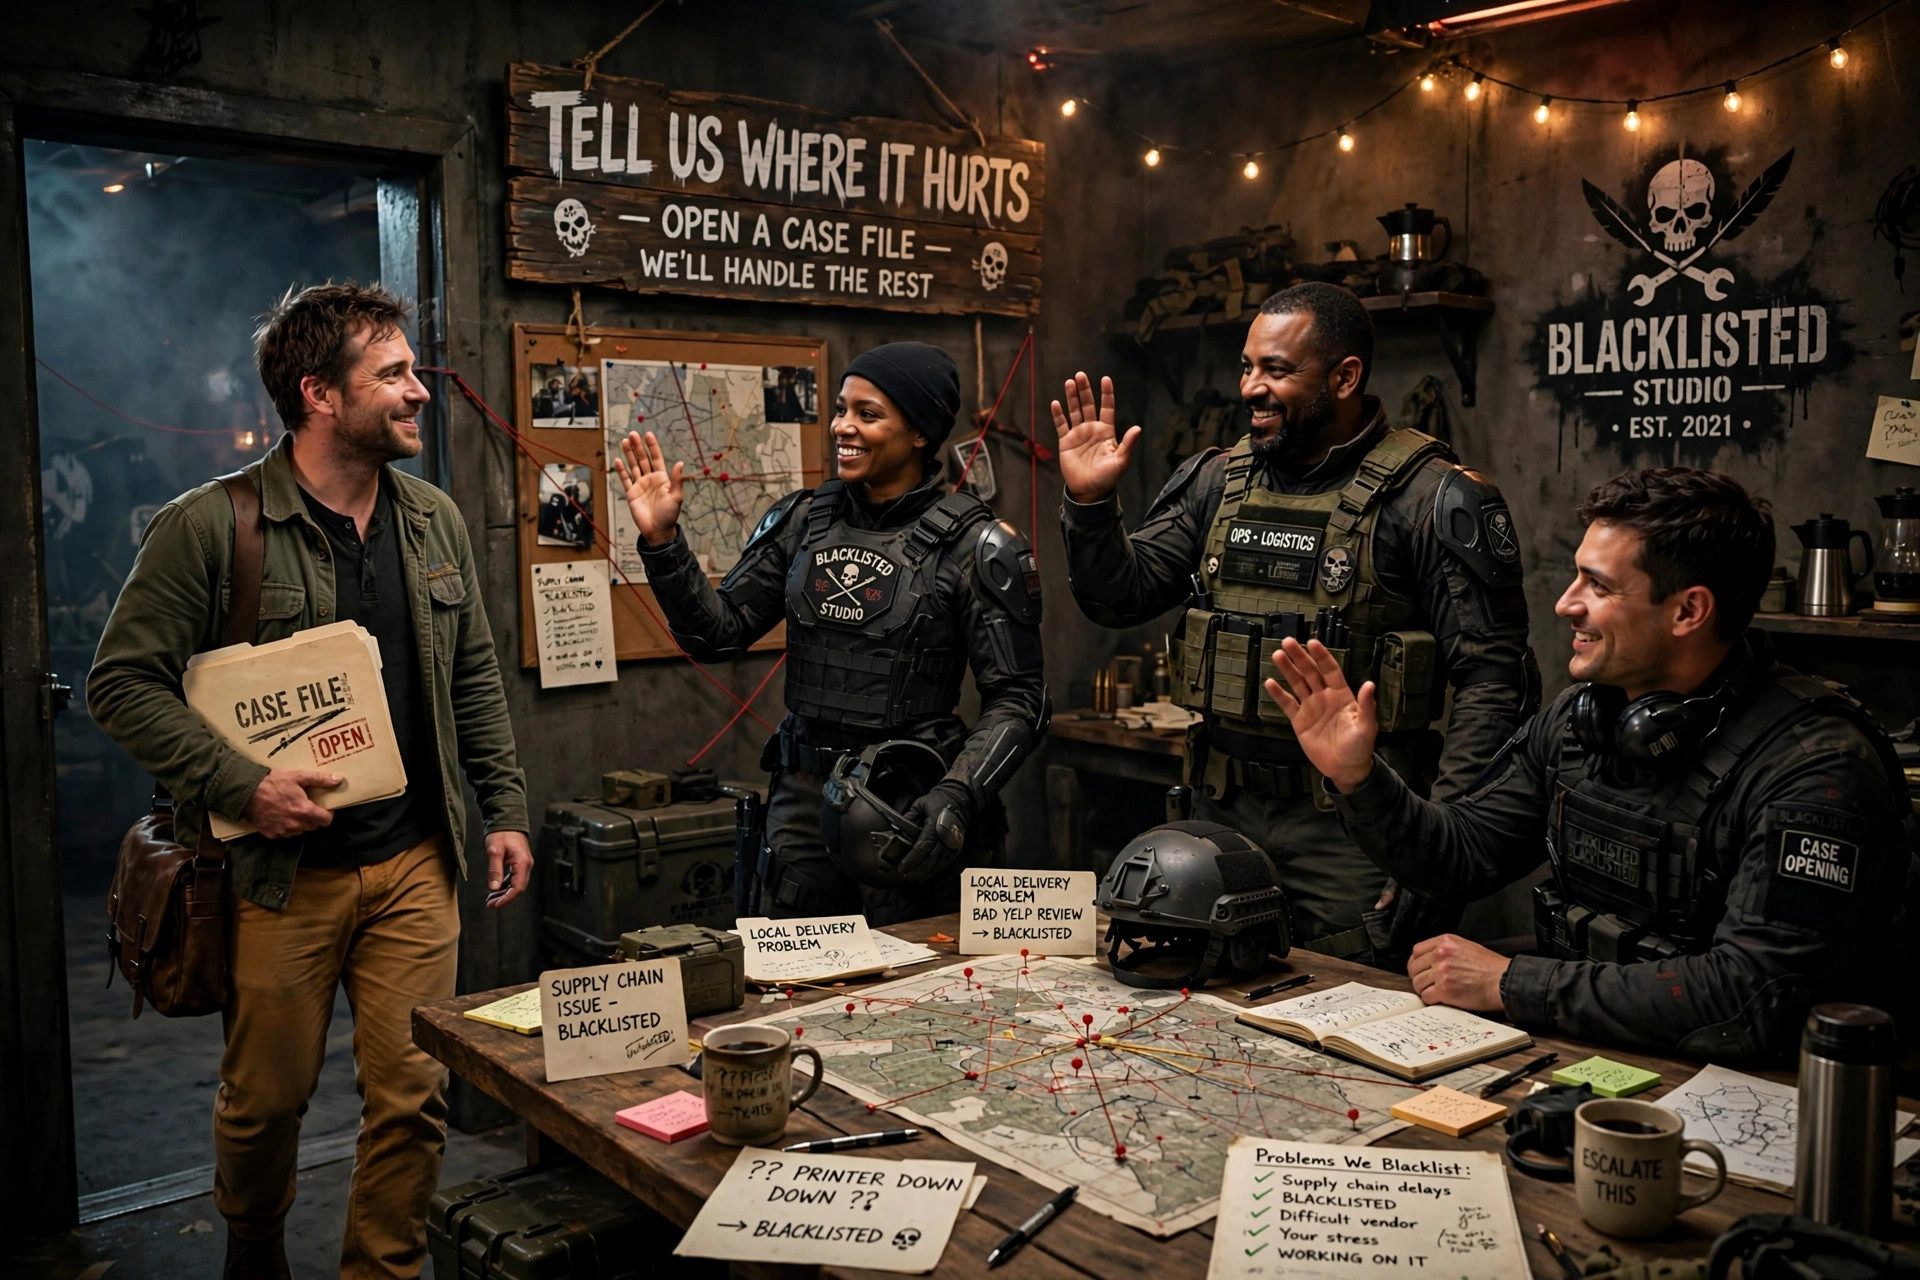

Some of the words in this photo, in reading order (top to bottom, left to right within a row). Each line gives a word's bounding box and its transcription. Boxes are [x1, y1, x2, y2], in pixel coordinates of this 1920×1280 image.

[530, 90, 654, 180] TELL
[669, 111, 725, 184] US
[737, 118, 867, 204] WHERE
[880, 141, 915, 205] IT
[922, 146, 1031, 226] HURTS
[661, 203, 740, 244] OPEN
[752, 213, 772, 247] A
[782, 216, 850, 254] CASE
[861, 225, 916, 259] FILE
[640, 248, 714, 282] WE'LL
[724, 256, 815, 289] HANDLE
[825, 264, 868, 294] THE
[878, 269, 933, 298] REST
[1548, 305, 1828, 375] BLACKLISTED
[1633, 375, 1731, 406] STUDIO
[1630, 416, 1672, 439] EST.
[1681, 414, 1731, 438] 2021
[1230, 527, 1252, 544] OPS
[1261, 531, 1315, 551] LOGISTICS
[815, 547, 894, 577] BLACKLISTED
[820, 602, 864, 621] STUDIO
[234, 690, 292, 729] CASE
[296, 676, 346, 712] FILE
[317, 725, 366, 759] OPEN
[1800, 838, 1840, 862] CASE
[1784, 854, 1849, 885] OPENING
[971, 875, 1008, 888] LOCAL
[1014, 876, 1071, 890] DELIVERY
[976, 889, 1035, 903] PROBLEM
[973, 908, 997, 920] BAD
[1003, 908, 1032, 921] YELP
[1038, 908, 1083, 920] REVIEW
[750, 926, 791, 940] LOCAL
[795, 922, 856, 937] DELIVERY
[993, 927, 1072, 939] BLACKLISTED
[757, 939, 821, 953] PROBLEM
[551, 974, 609, 997] SUPPLY
[617, 968, 663, 988] CHAIN
[558, 997, 602, 1017] ISSUE
[558, 1012, 661, 1041] BLACKLISTED
[1256, 1148, 1336, 1168] Problems
[1344, 1155, 1371, 1169] We
[1382, 1158, 1471, 1176] Blacklist:
[1582, 1148, 1662, 1180] ESCALATE
[748, 1160, 783, 1180] ??
[793, 1165, 885, 1186] PRINTER
[896, 1174, 963, 1192] DOWN
[1282, 1174, 1338, 1190] Supply
[1347, 1176, 1389, 1192] chain
[1398, 1181, 1451, 1199] delays
[767, 1186, 836, 1204] DOWN
[849, 1190, 879, 1211] ??
[1283, 1192, 1397, 1210] BLACKLISTED
[1595, 1180, 1636, 1206] THIS
[753, 1220, 883, 1243] BLACKLISTED
[1280, 1209, 1350, 1225] Difficult
[1360, 1216, 1419, 1230] vendor
[1279, 1227, 1318, 1242] Your
[1327, 1234, 1379, 1246] stress
[1277, 1248, 1363, 1264] WORKING
[1372, 1254, 1398, 1266] ON
[1408, 1256, 1428, 1267] IT
